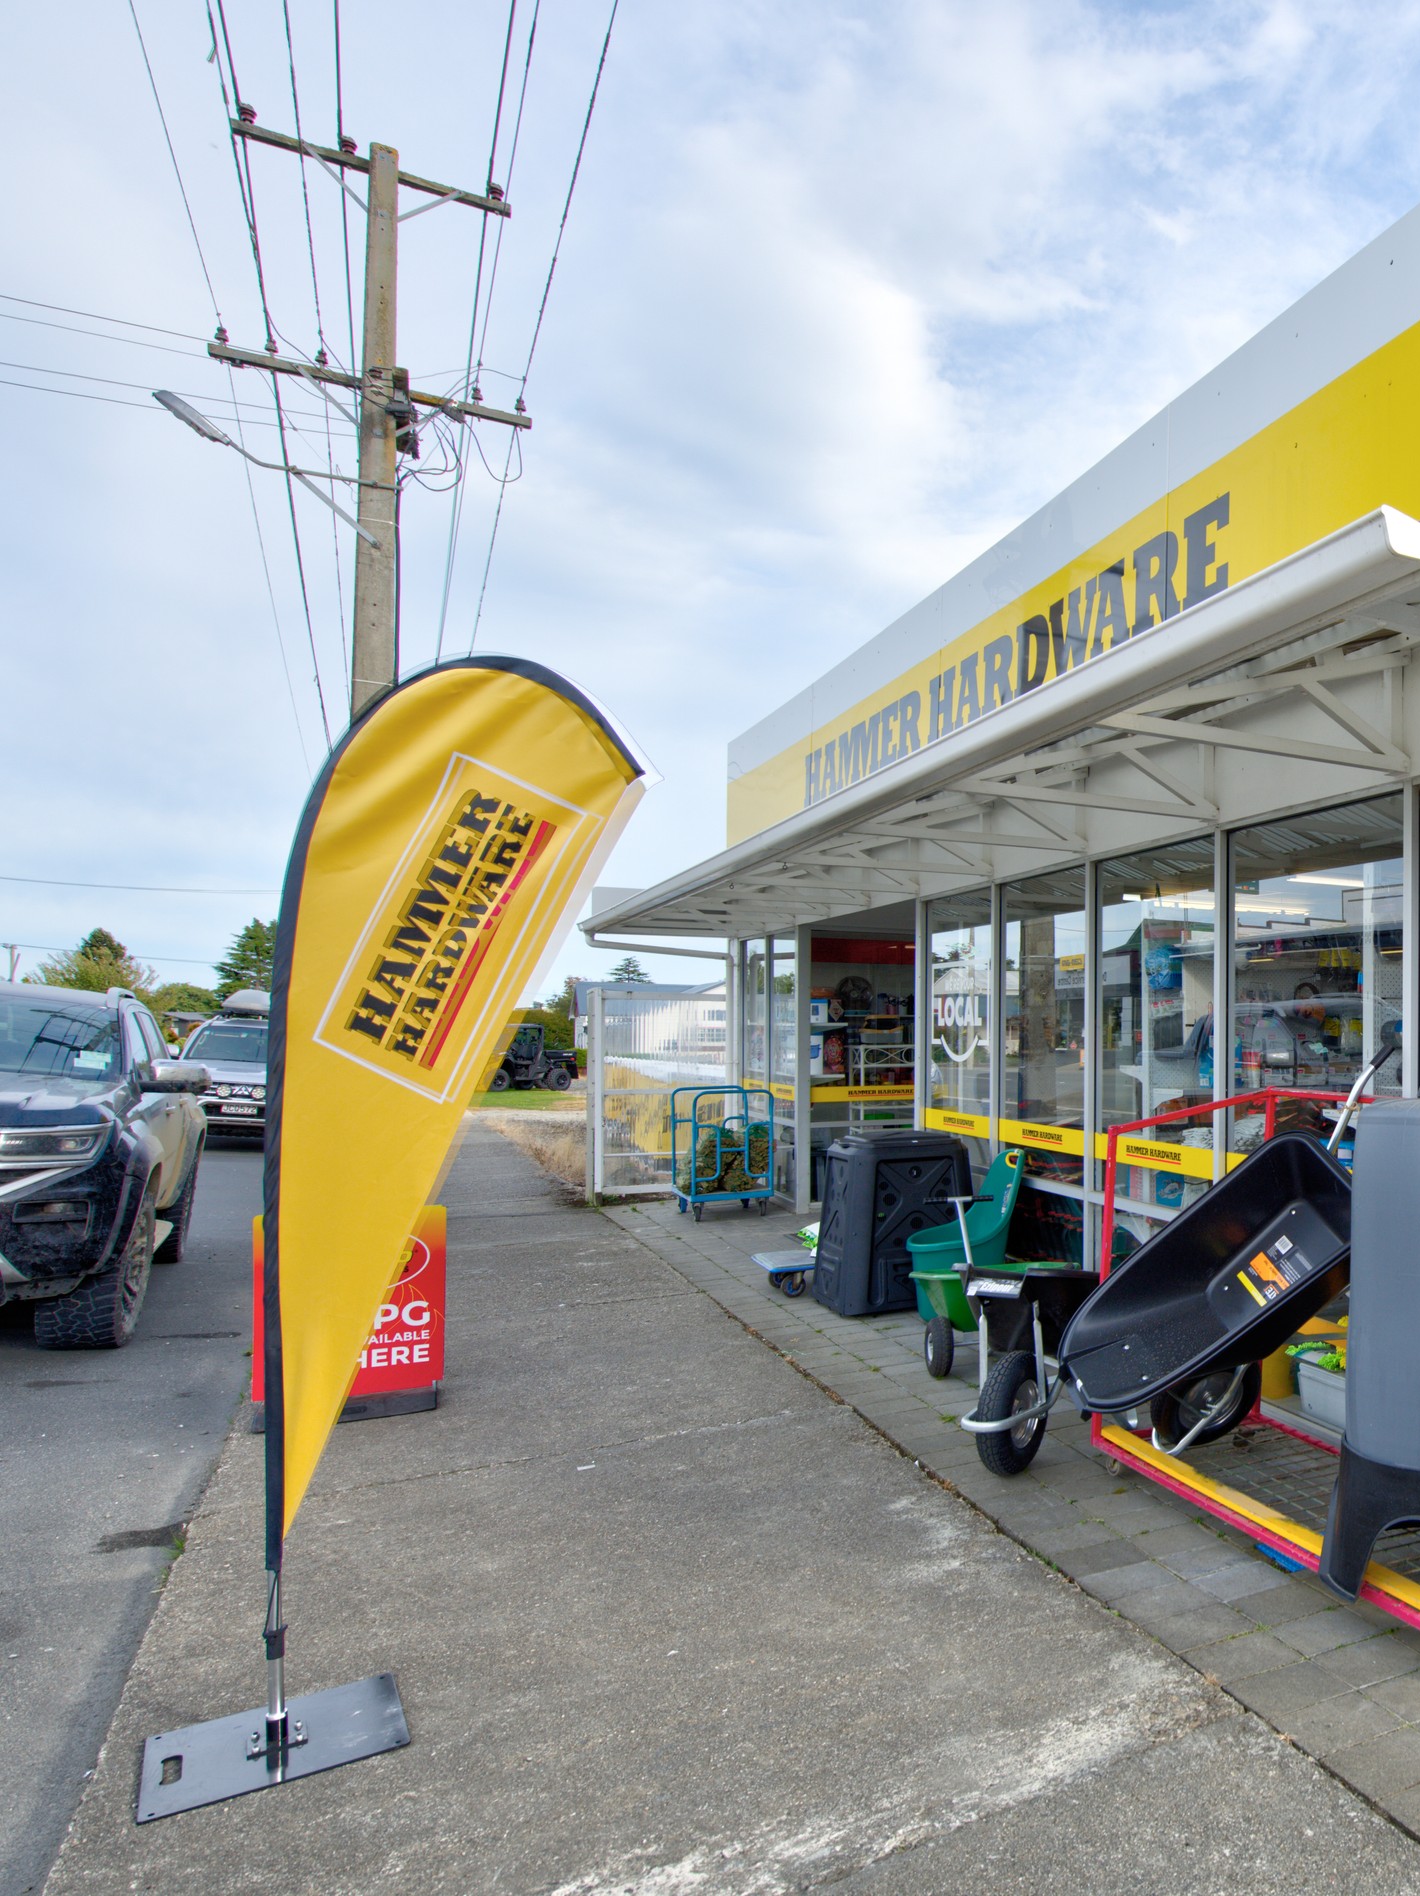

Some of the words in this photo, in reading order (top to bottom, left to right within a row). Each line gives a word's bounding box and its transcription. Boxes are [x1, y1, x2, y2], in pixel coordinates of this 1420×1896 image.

[803, 690, 922, 807] HAMMER
[927, 491, 1230, 740] HARDWARE
[344, 789, 502, 1045] HAMMER
[385, 803, 537, 1063] HARDWARE
[938, 996, 982, 1026] LOCAL
[1126, 1145, 1148, 1156] HAMMER
[1150, 1149, 1181, 1162] HARDWARE
[373, 1300, 431, 1330] PG
[363, 1329, 430, 1346] AILABLE
